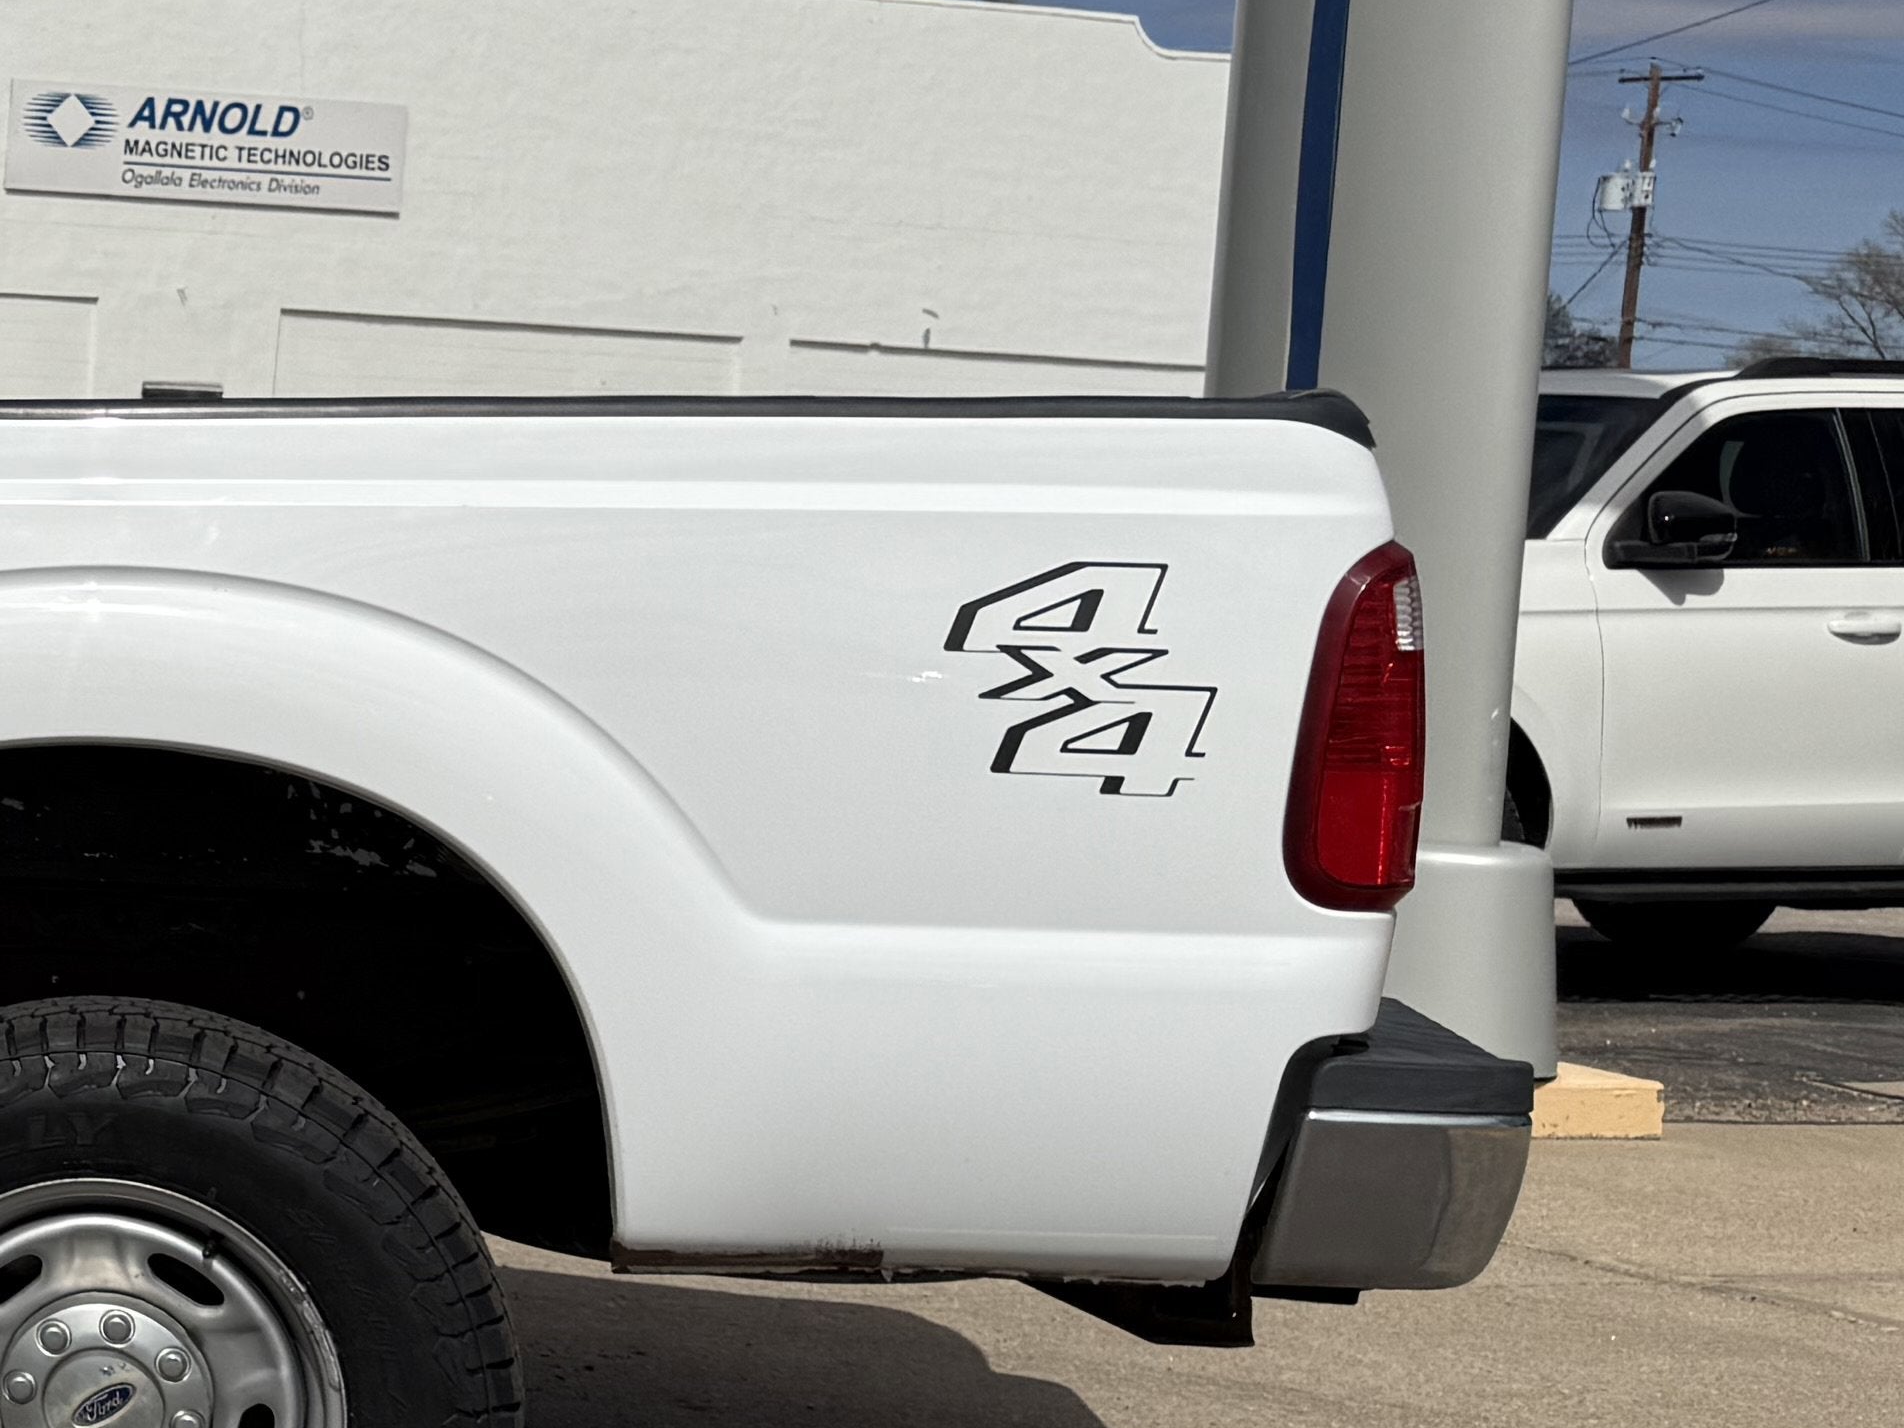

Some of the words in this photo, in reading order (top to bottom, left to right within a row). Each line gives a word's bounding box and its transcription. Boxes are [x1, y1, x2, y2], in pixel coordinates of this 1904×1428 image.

[123, 138, 229, 162] MAGNETIC
[234, 145, 390, 172] TECHNOLOGIES
[121, 167, 183, 189] Ogallala
[188, 172, 262, 193] Electronics
[267, 177, 321, 196] Division
